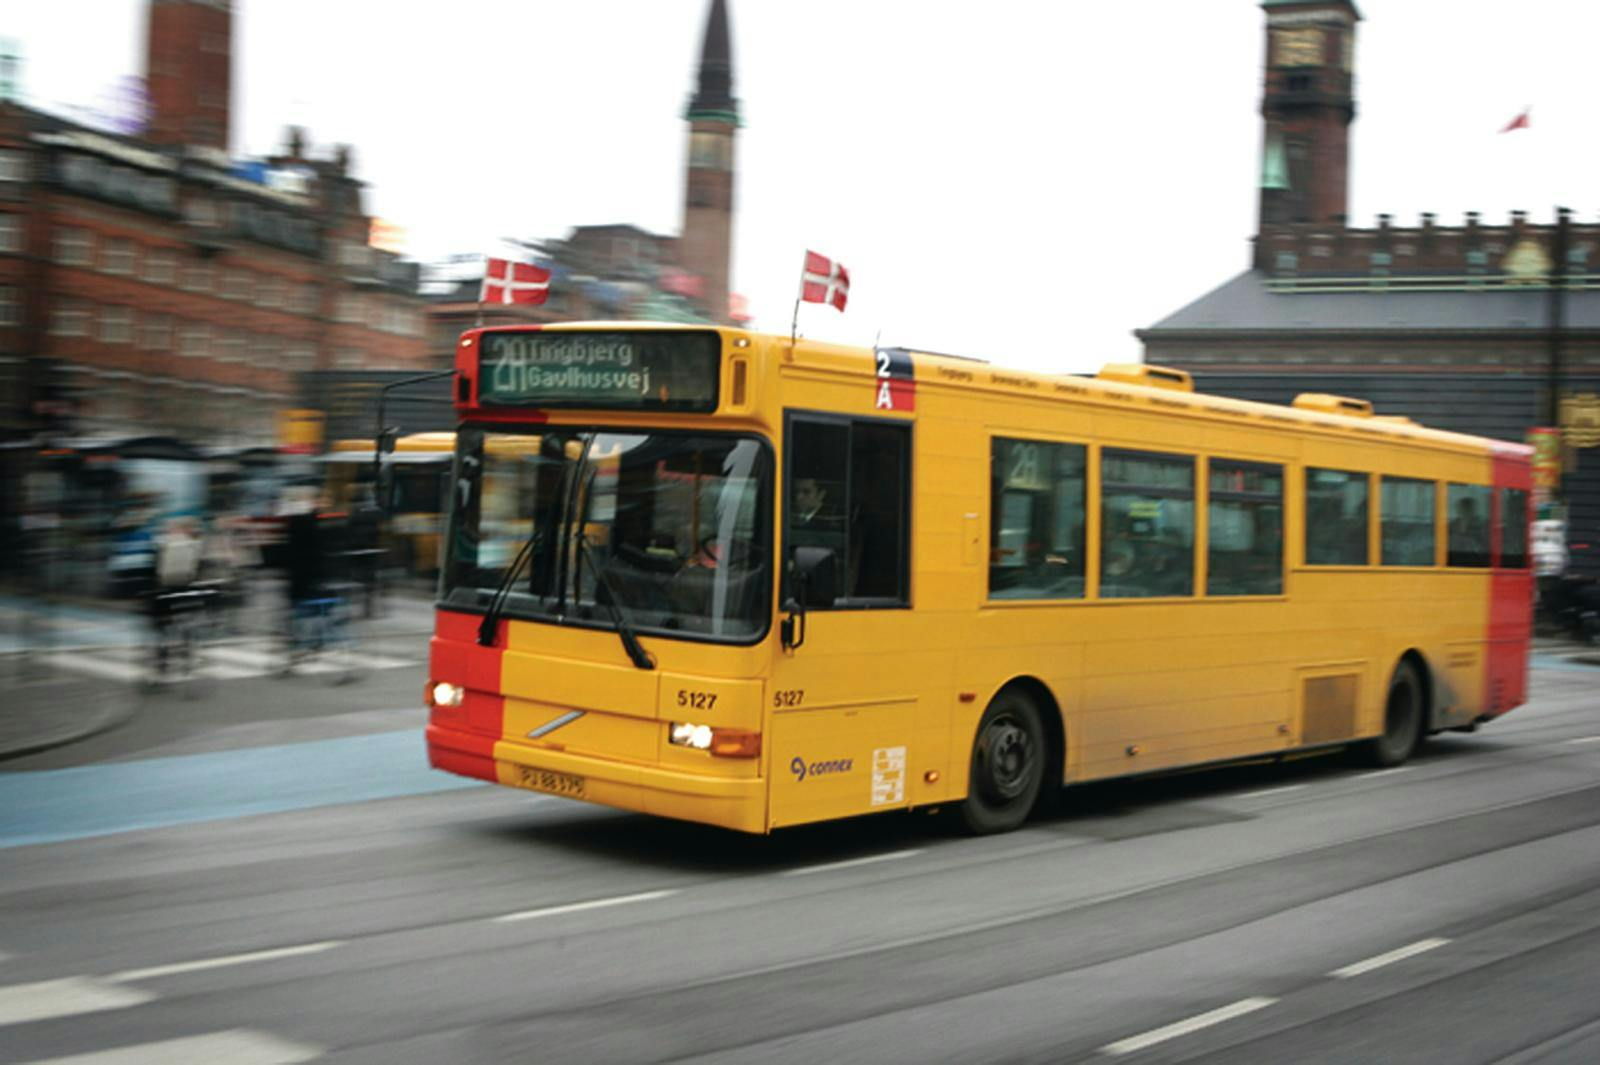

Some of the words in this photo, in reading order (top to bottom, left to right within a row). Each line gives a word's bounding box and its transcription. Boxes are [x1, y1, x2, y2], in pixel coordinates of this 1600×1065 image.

[529, 338, 633, 366] Tingbjerg
[877, 351, 891, 378] 2
[528, 366, 650, 394] Gavlhusvej
[876, 381, 893, 409] A
[677, 690, 717, 710] 5127
[773, 690, 804, 707] 5127
[809, 758, 853, 776] connex
